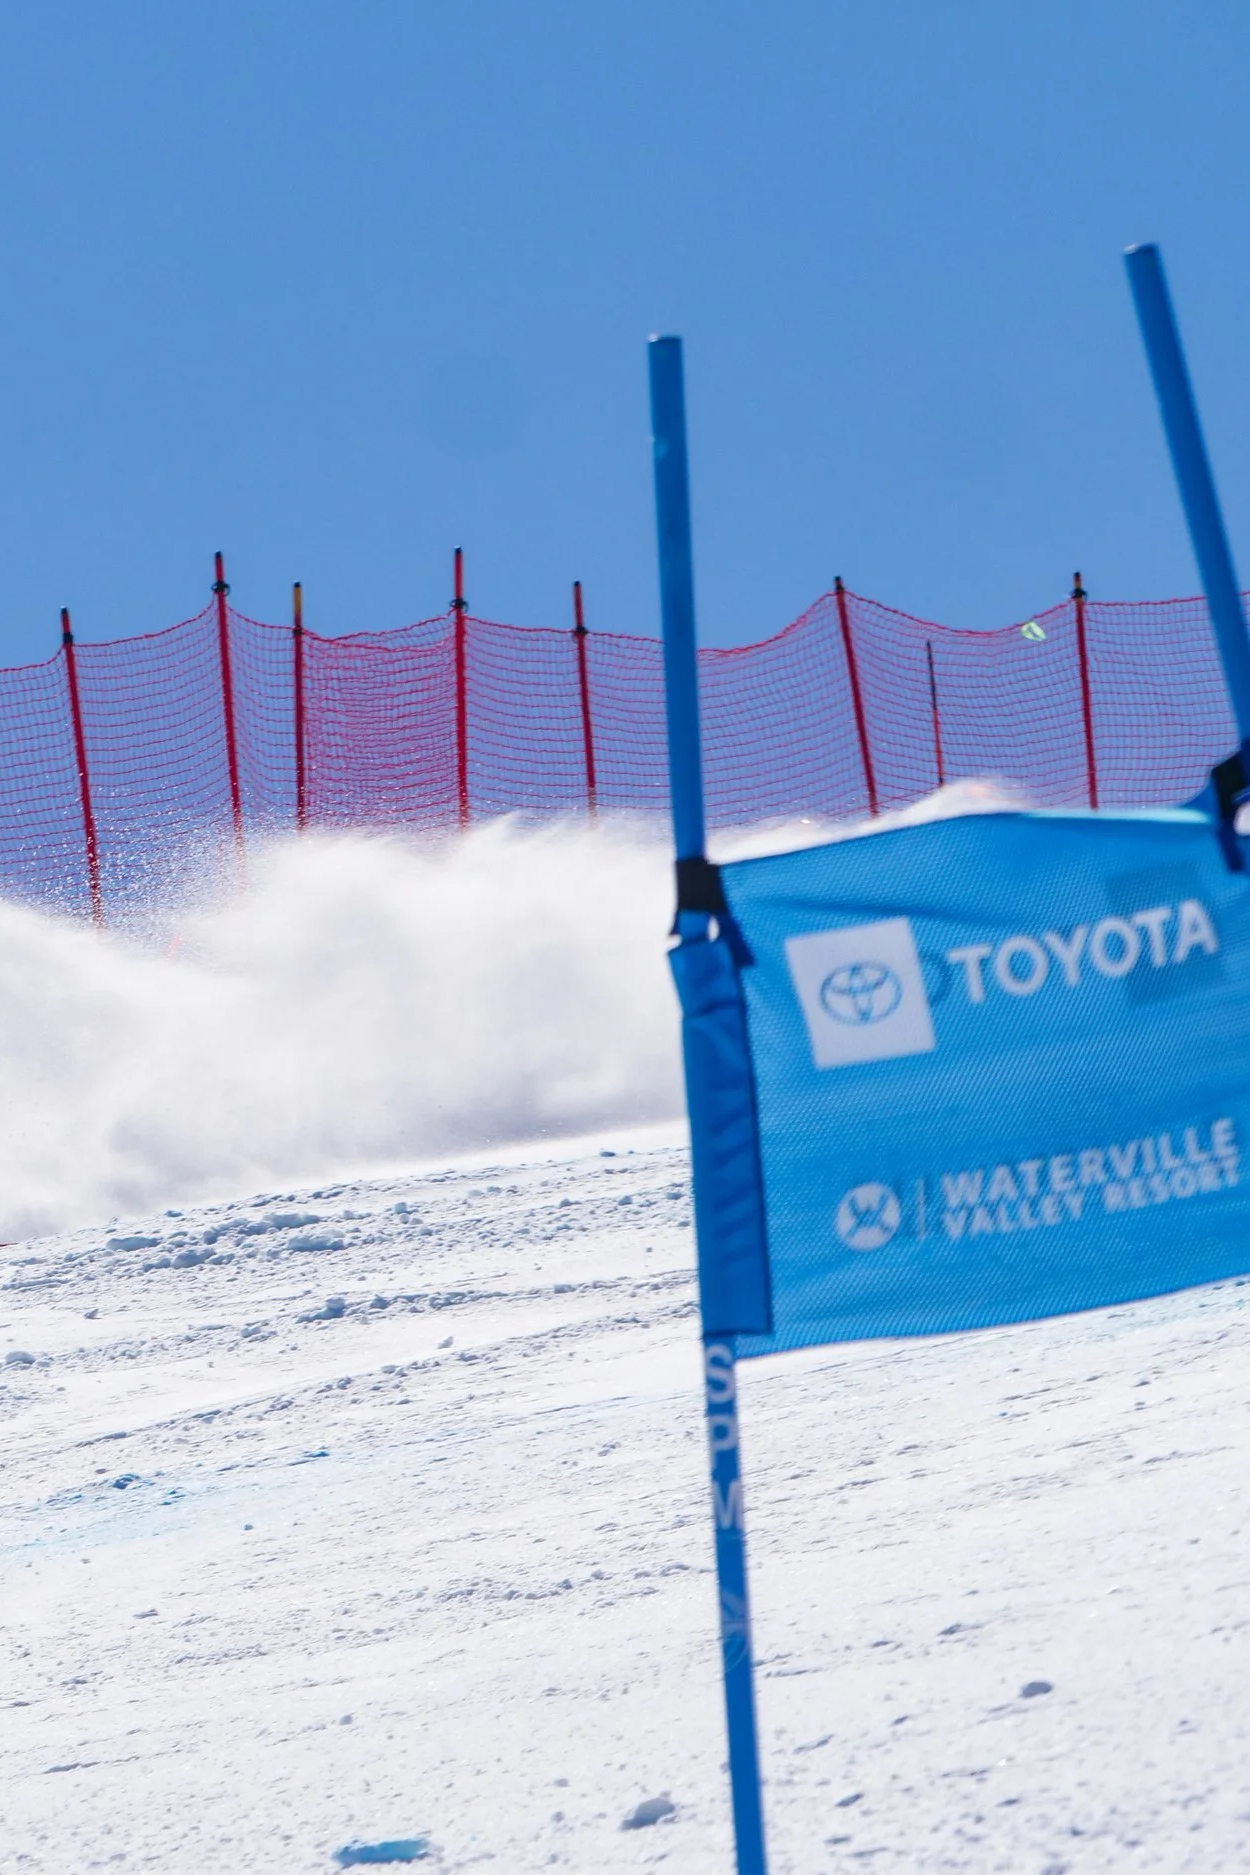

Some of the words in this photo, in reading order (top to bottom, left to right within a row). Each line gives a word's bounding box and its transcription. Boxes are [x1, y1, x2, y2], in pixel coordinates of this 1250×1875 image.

[950, 898, 1219, 1005] TOYOTA
[941, 1190, 1085, 1240] VALLEY
[1101, 1151, 1241, 1215] RESORT
[942, 1117, 1237, 1207] WATERVILLE
[704, 1342, 746, 1532] SPM
